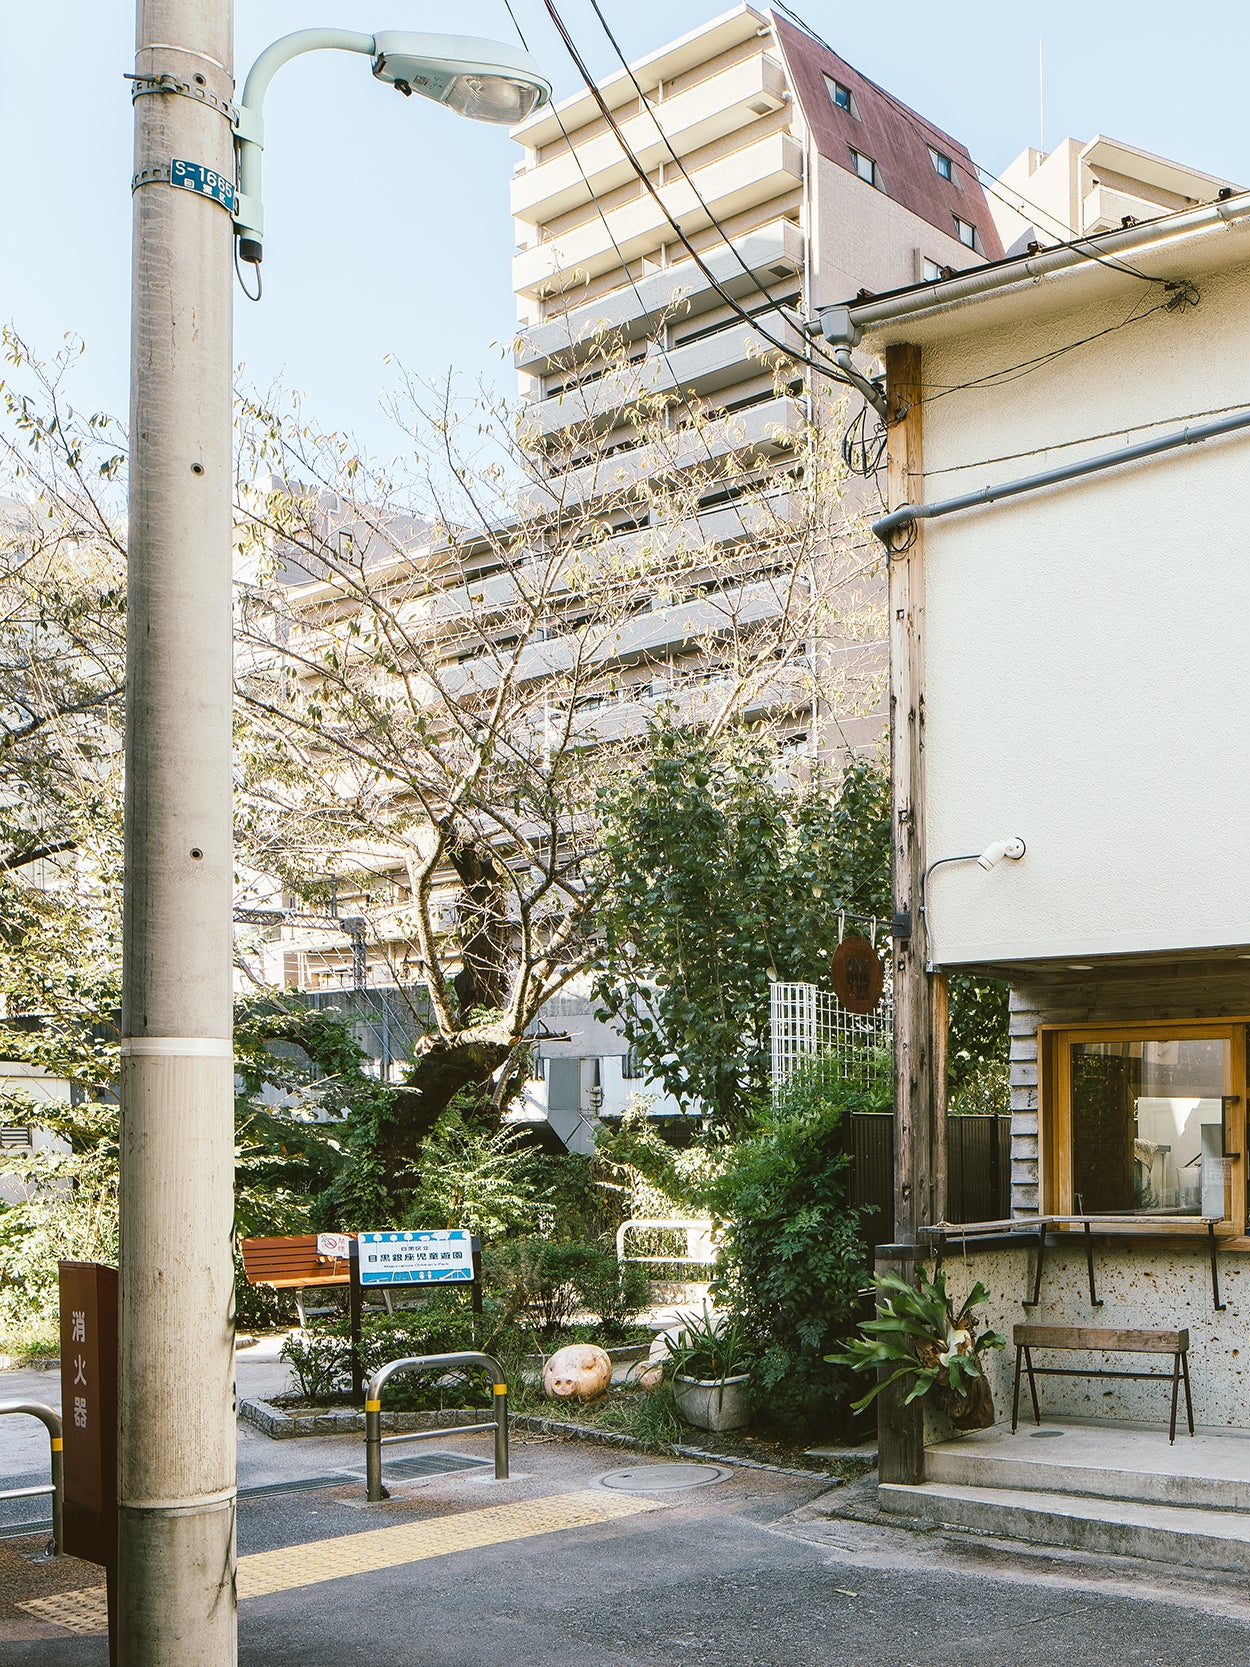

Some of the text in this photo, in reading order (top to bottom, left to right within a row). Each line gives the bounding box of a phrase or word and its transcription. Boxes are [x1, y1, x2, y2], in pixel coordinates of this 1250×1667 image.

[175, 161, 233, 198] S-1665
[368, 1251, 463, 1263] 目黒銀座児童遊園
[71, 1310, 88, 1430] 消火器
